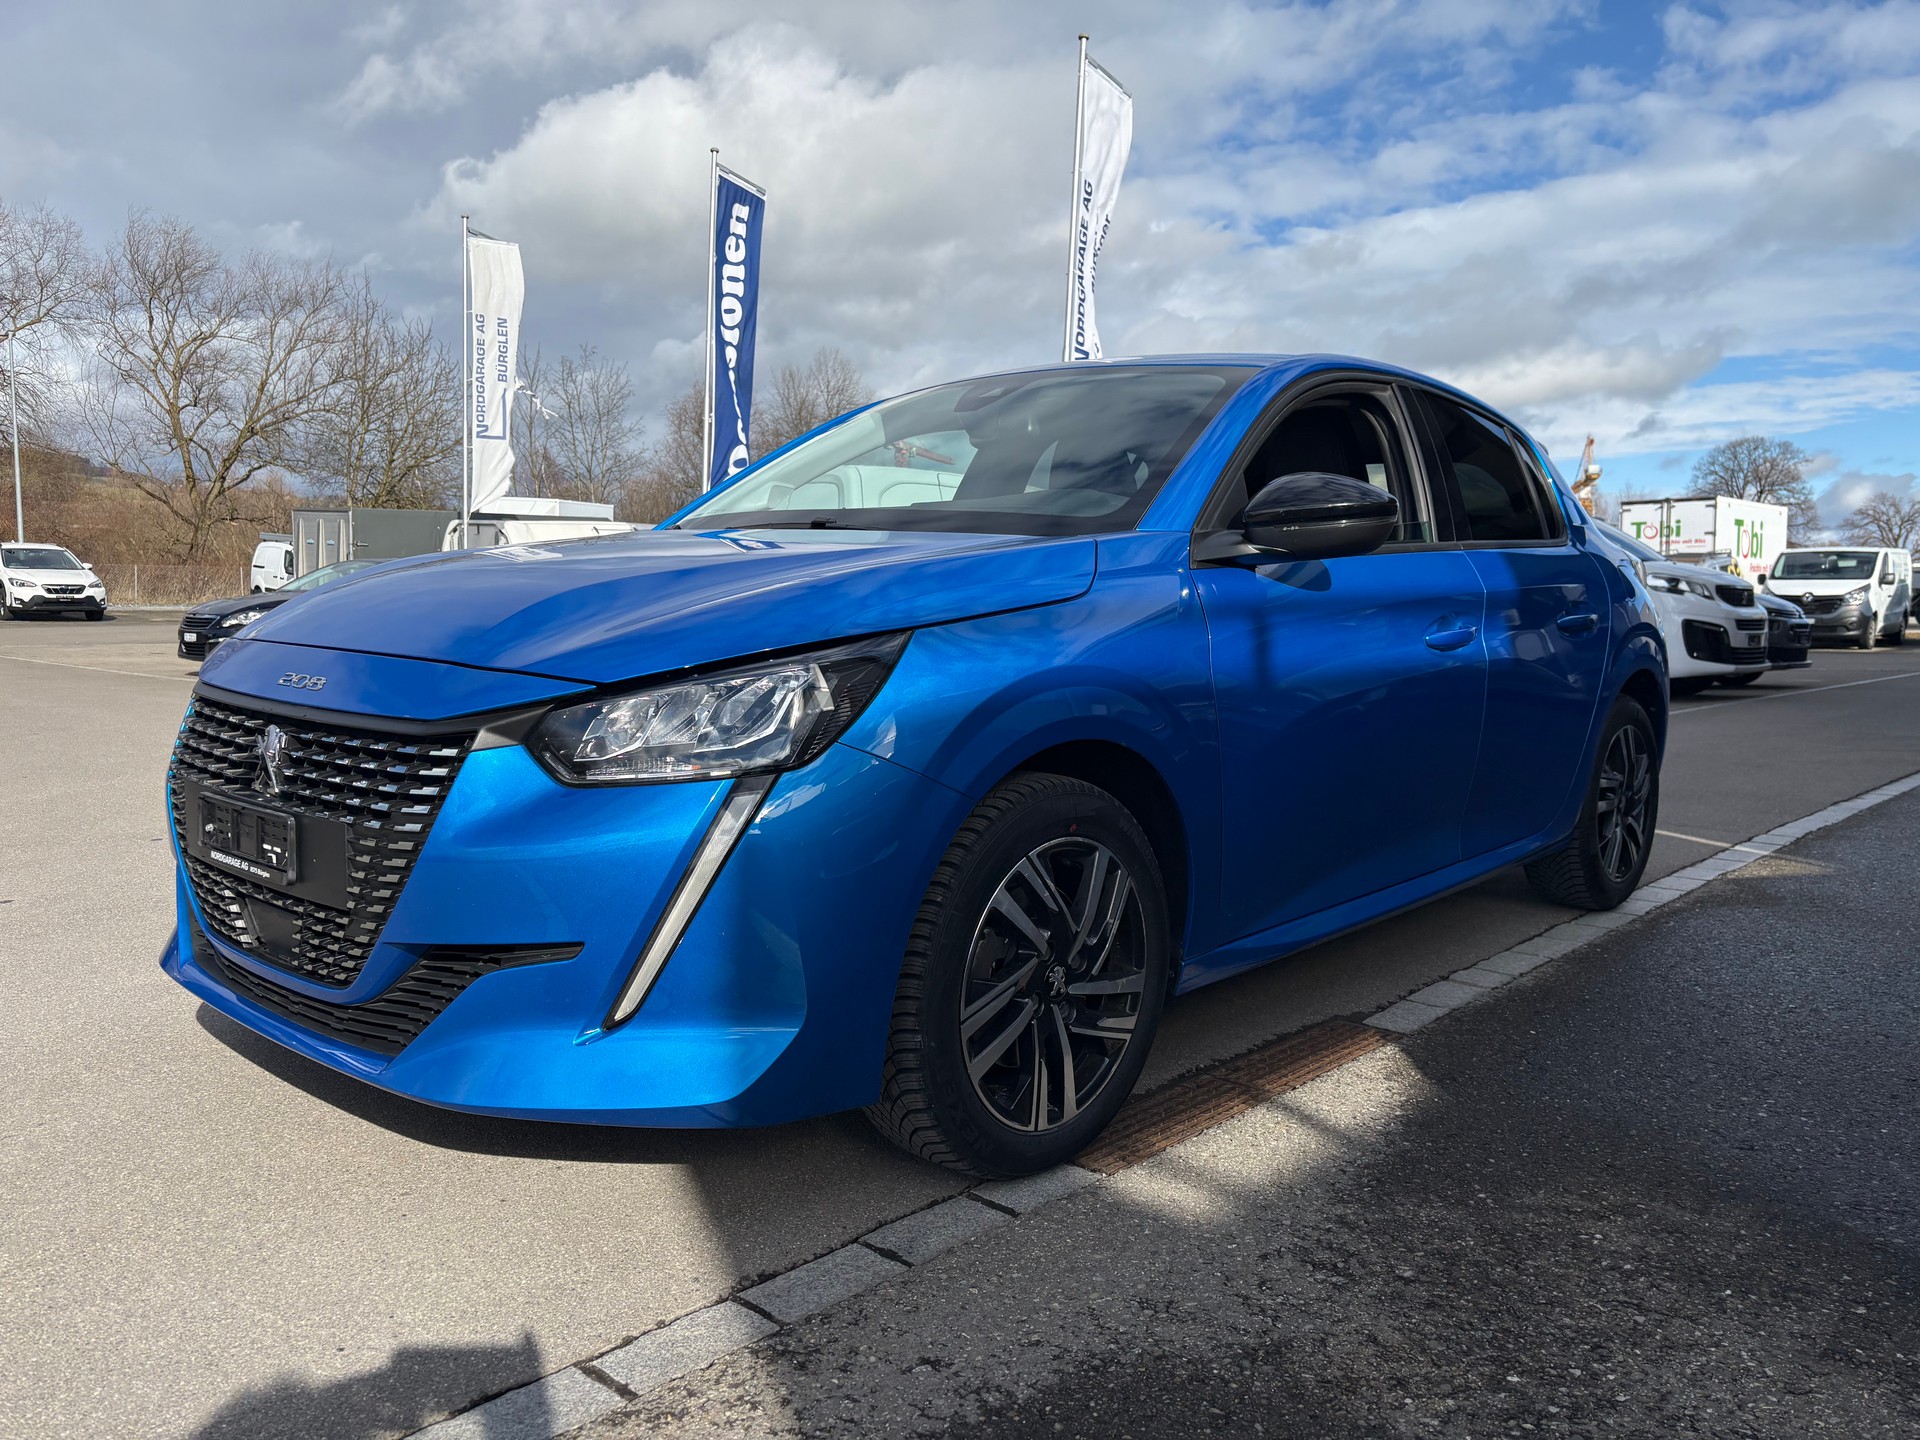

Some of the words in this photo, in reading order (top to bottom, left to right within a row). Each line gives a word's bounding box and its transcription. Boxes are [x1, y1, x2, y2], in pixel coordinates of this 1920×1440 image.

[1074, 217, 1089, 360] NORDGARAGE
[1082, 179, 1093, 213] AG
[475, 313, 486, 334] AG
[496, 317, 508, 383] BÜRGLEN
[475, 338, 489, 439] NORDGARAGE
[1631, 519, 1681, 539] Tobi
[1735, 519, 1763, 558] Tobi
[277, 672, 327, 691] 208
[211, 851, 241, 867] NORDGARAGE
[241, 862, 248, 870] AG
